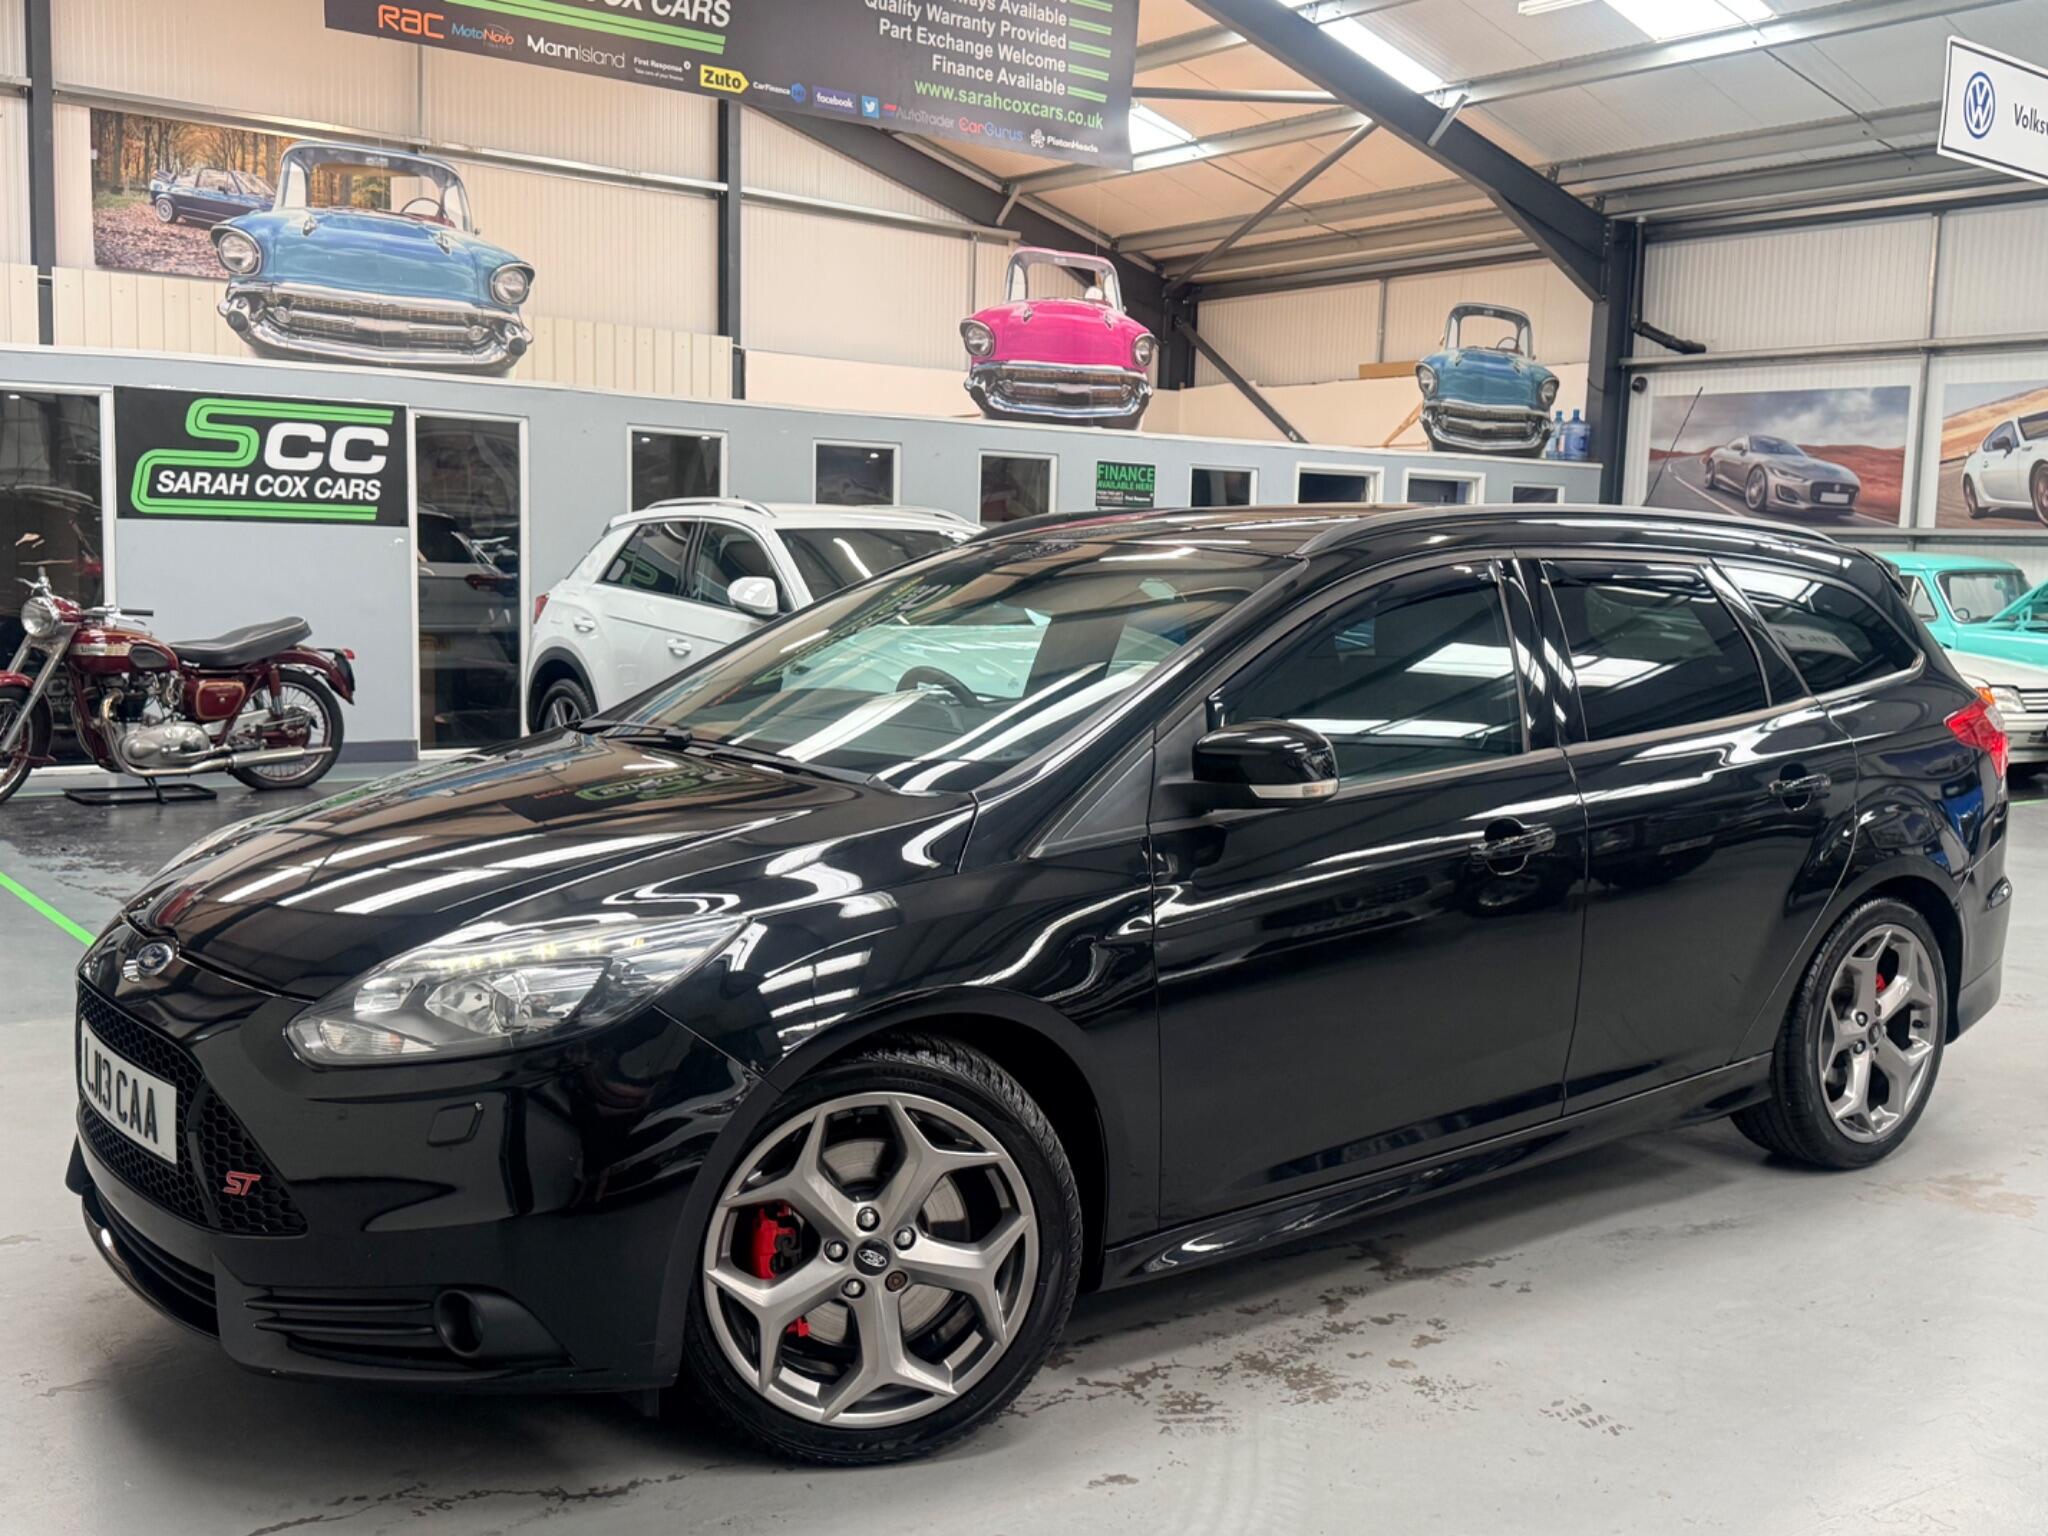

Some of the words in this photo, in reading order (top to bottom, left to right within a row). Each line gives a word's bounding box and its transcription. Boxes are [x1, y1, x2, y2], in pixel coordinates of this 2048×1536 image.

[651, 0, 731, 28] CARS
[864, 0, 922, 22] Quality
[926, 3, 997, 38] Warranty
[1000, 20, 1067, 50] Provided
[999, 0, 1067, 27] Available
[451, 22, 515, 46] MotoNovo
[879, 18, 913, 42] Part
[916, 27, 994, 60] Exchange
[997, 43, 1067, 72] Welcome
[527, 34, 626, 69] MannIsland
[633, 56, 649, 67] First
[650, 59, 683, 73] Response
[703, 69, 742, 88] Zuto
[932, 54, 994, 82] Finance
[996, 69, 1066, 96] Available
[752, 81, 791, 96] CarFinance
[815, 92, 854, 109] facebook
[896, 106, 954, 129] AutoTrader
[914, 80, 1104, 131] www.sarahcoxcars.co.uk
[958, 117, 1024, 142] CarGurus
[2014, 102, 2048, 137] Volks
[1047, 135, 1099, 153] PistonHeads
[156, 470, 249, 496] SARAH
[254, 473, 310, 498] COX
[314, 477, 381, 501] CARS
[1097, 463, 1154, 483] FINANCE
[1098, 480, 1134, 491] AVAILABLE
[115, 1069, 159, 1145] CAA
[223, 1170, 262, 1196] ST
